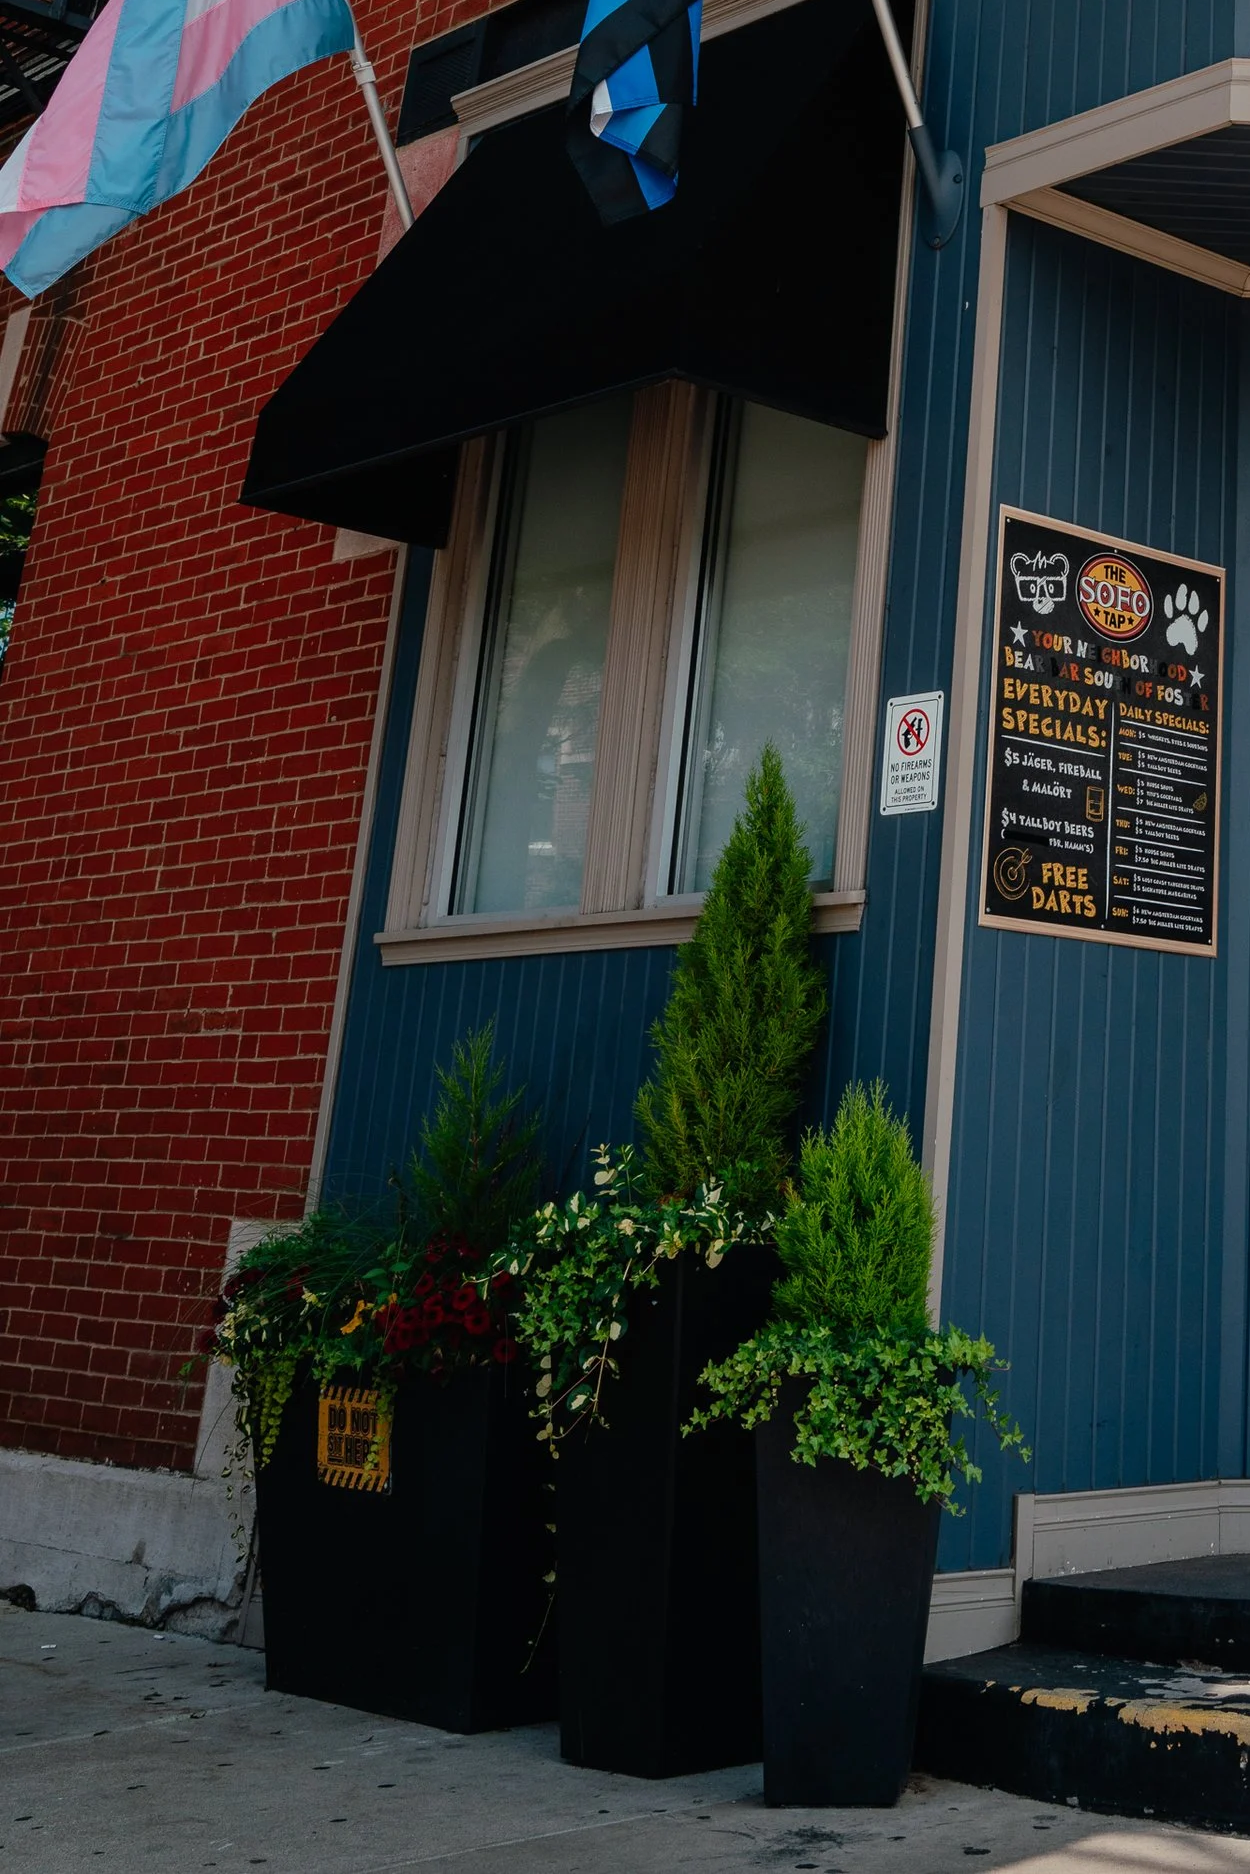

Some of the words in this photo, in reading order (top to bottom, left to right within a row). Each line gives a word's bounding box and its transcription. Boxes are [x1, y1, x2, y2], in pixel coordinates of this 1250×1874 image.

[1103, 565, 1126, 584] THE
[1078, 576, 1150, 617] SOFO
[1103, 611, 1126, 629] TAP
[1032, 629, 1073, 654] YOUR
[1076, 639, 1187, 681] NEIGHBORHOOD
[1003, 646, 1046, 673] BEAR
[1050, 657, 1080, 681] BAR
[1084, 667, 1132, 694] SOUTH
[1135, 681, 1153, 698] OF
[1156, 685, 1209, 711] FOSTER
[1003, 678, 1109, 720] EVERYDAY
[1002, 708, 1107, 748] SPECIALS:
[1119, 703, 1152, 722] DAILY
[1155, 711, 1210, 734] SPECIALS:
[1119, 727, 1136, 738] MON:
[890, 763, 900, 773] NO
[900, 758, 932, 772] FIREARMS
[1004, 747, 1020, 767] $5
[1022, 752, 1056, 773] JÄGER,
[1058, 762, 1102, 780] FIREBALL
[1117, 752, 1133, 761] TUE:
[890, 774, 900, 785] OR
[900, 771, 931, 783] WEAPONS
[891, 795, 902, 803] THIS
[902, 793, 927, 803] PROPERTY
[894, 787, 916, 795] ALLOWED
[917, 785, 925, 793] ON
[1022, 779, 1030, 792] &
[1031, 781, 1073, 799] MALÖRT
[1117, 784, 1136, 795] WED:
[1001, 807, 1017, 827] $4
[1064, 821, 1095, 838] BEERS
[1115, 819, 1131, 829] THU:
[1114, 846, 1129, 856] FRI:
[1041, 862, 1089, 890] FREE
[1113, 875, 1130, 886] SAT:
[1032, 886, 1097, 918] DARTS
[1112, 907, 1129, 917] SUN:
[328, 1404, 347, 1433] DO
[351, 1407, 378, 1436] NOT
[345, 1434, 380, 1471] HER
